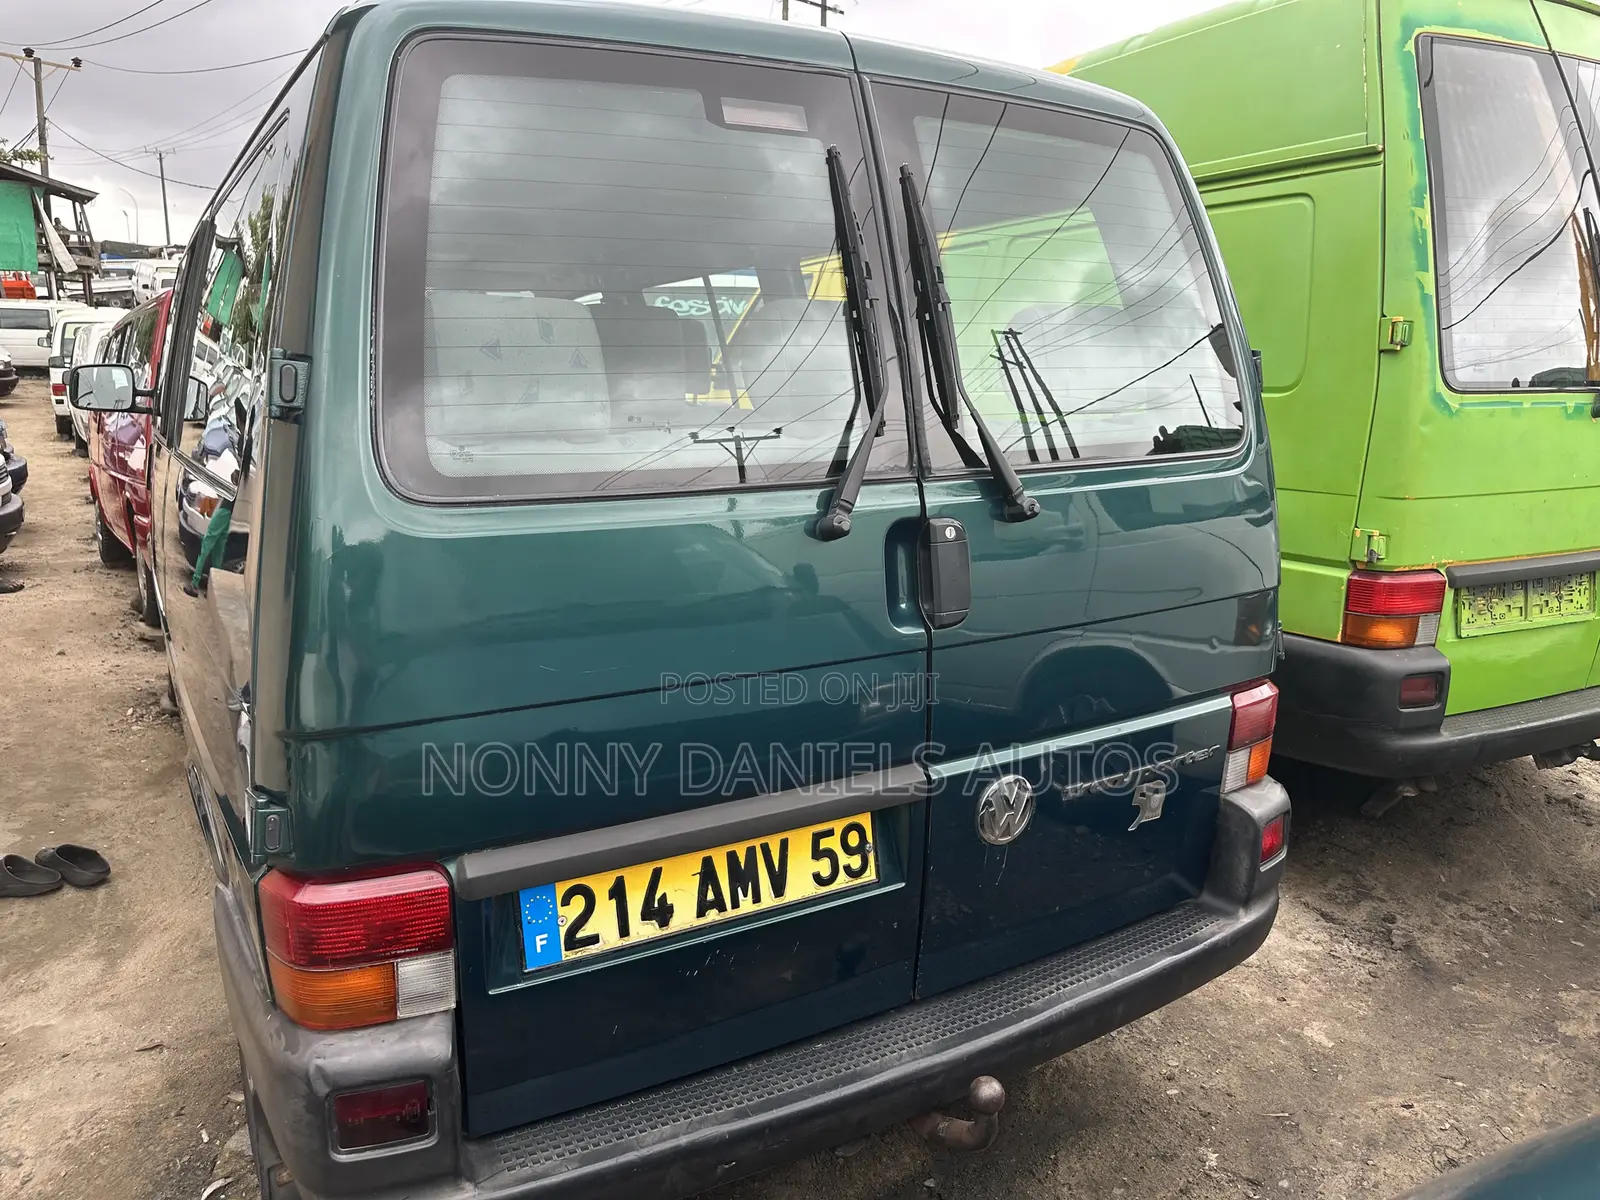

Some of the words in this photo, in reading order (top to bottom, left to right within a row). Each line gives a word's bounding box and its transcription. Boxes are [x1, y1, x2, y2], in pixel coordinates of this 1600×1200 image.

[560, 866, 675, 952] 214
[695, 837, 789, 919] AMV
[810, 821, 869, 887] 59
[535, 933, 549, 954] F
